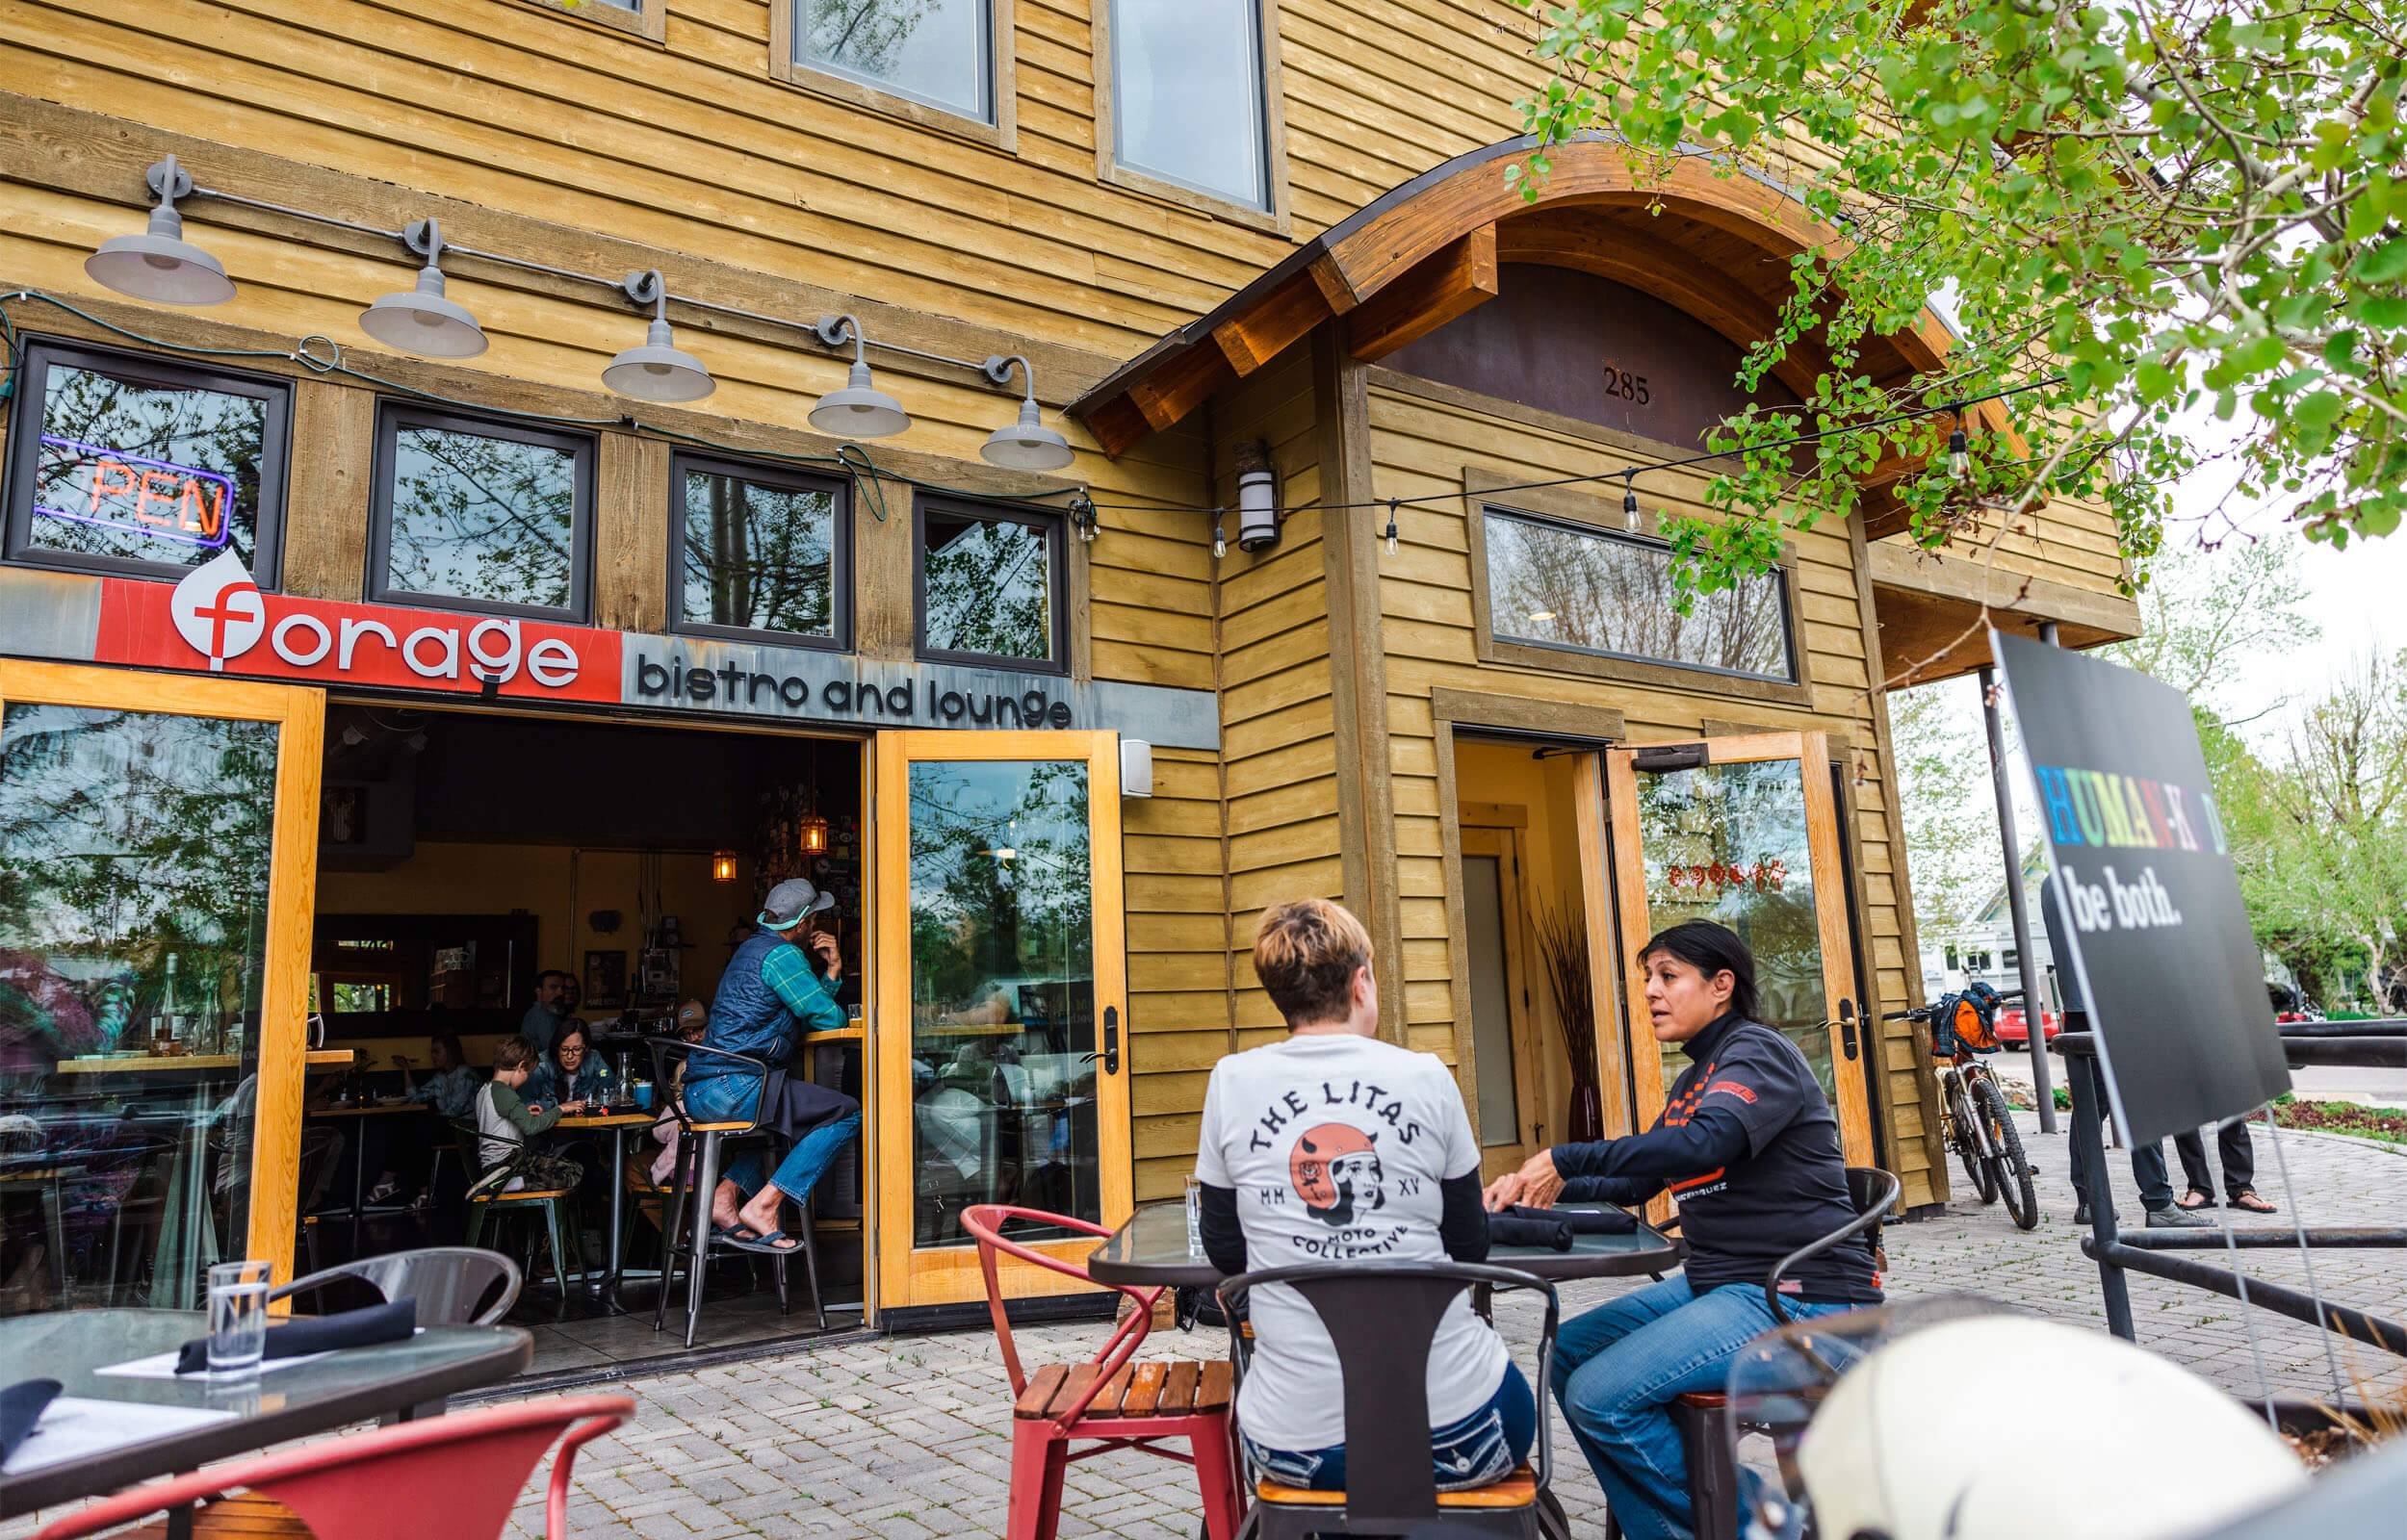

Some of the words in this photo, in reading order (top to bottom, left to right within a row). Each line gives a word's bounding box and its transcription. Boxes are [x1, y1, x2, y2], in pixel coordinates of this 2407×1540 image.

[1603, 367, 1649, 405] 285
[40, 452, 225, 536] PEN
[193, 580, 580, 687] forage
[636, 653, 810, 708] bistro
[822, 678, 915, 717] and
[929, 680, 1074, 730] lounge
[2034, 764, 2227, 855] HUMAN-KD
[2061, 864, 2112, 932] be
[2103, 864, 2184, 930] both.
[1251, 1090, 1308, 1153] THE
[1322, 1080, 1421, 1145] LITAS
[1260, 1187, 1285, 1205] MM
[1397, 1177, 1420, 1196] XV
[1328, 1228, 1376, 1245] MOTO
